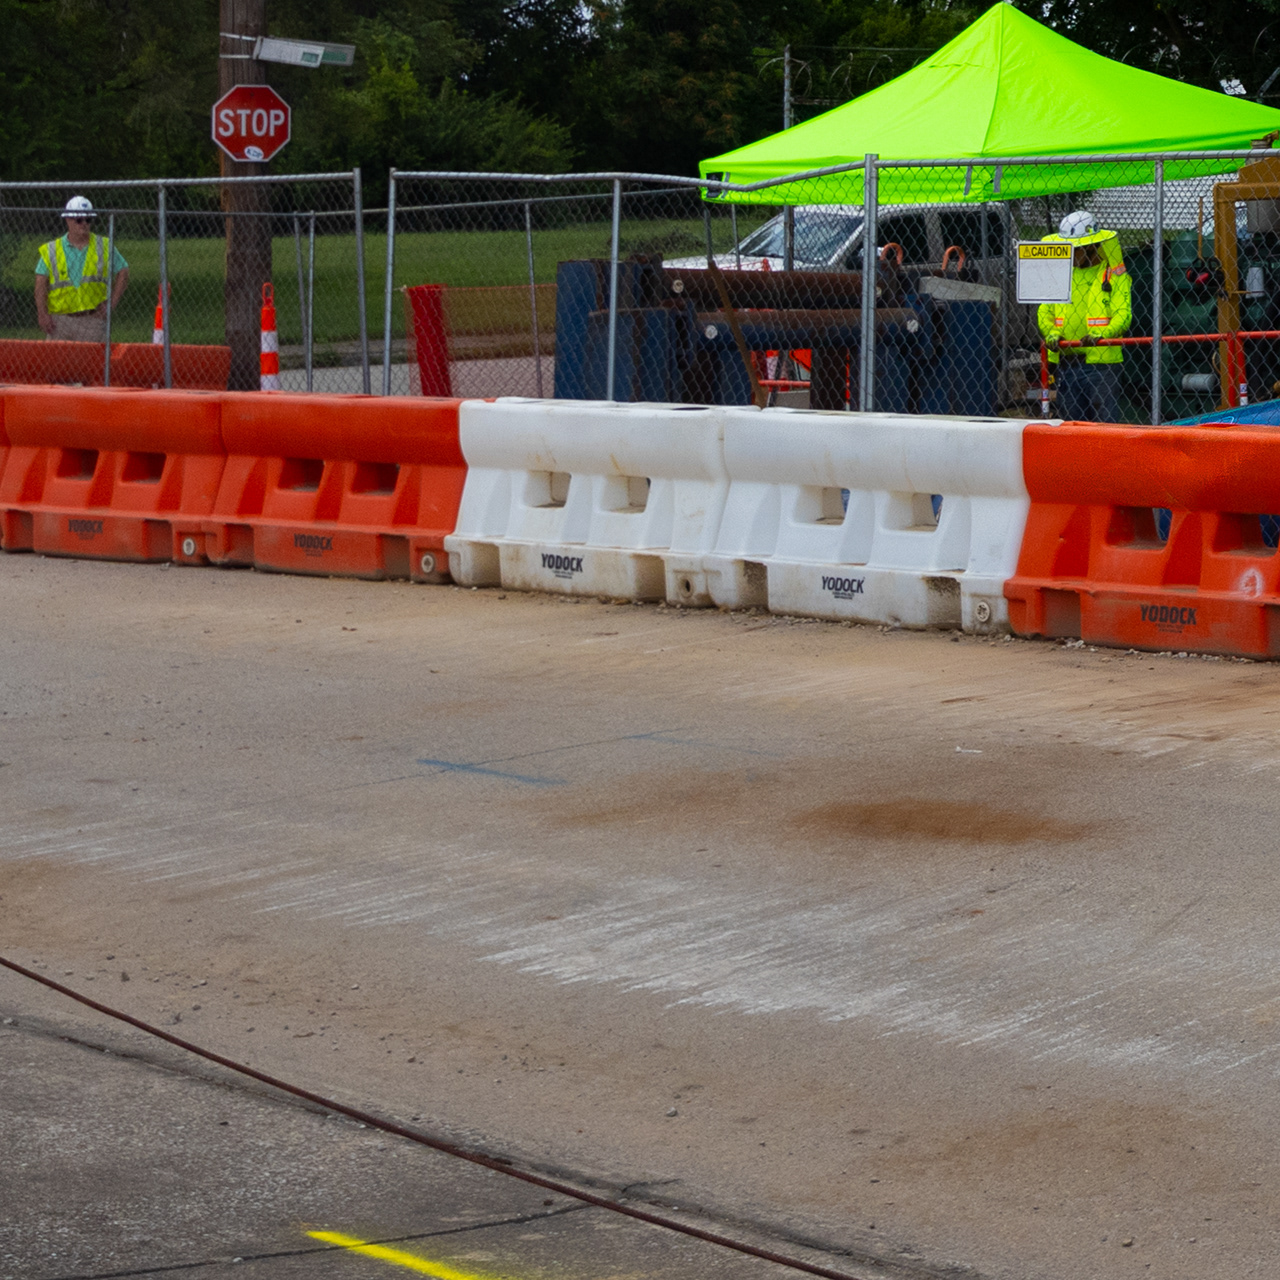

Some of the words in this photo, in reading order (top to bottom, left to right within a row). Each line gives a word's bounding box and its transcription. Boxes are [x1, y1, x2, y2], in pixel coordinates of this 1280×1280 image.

[218, 108, 285, 137] STOP
[1031, 246, 1069, 257] CAUTION
[68, 519, 103, 535] YODOCK
[293, 533, 334, 551] YODOCK
[541, 553, 584, 572] YODOCK
[822, 576, 864, 594] YODOCK
[1140, 604, 1197, 625] YODOCK
